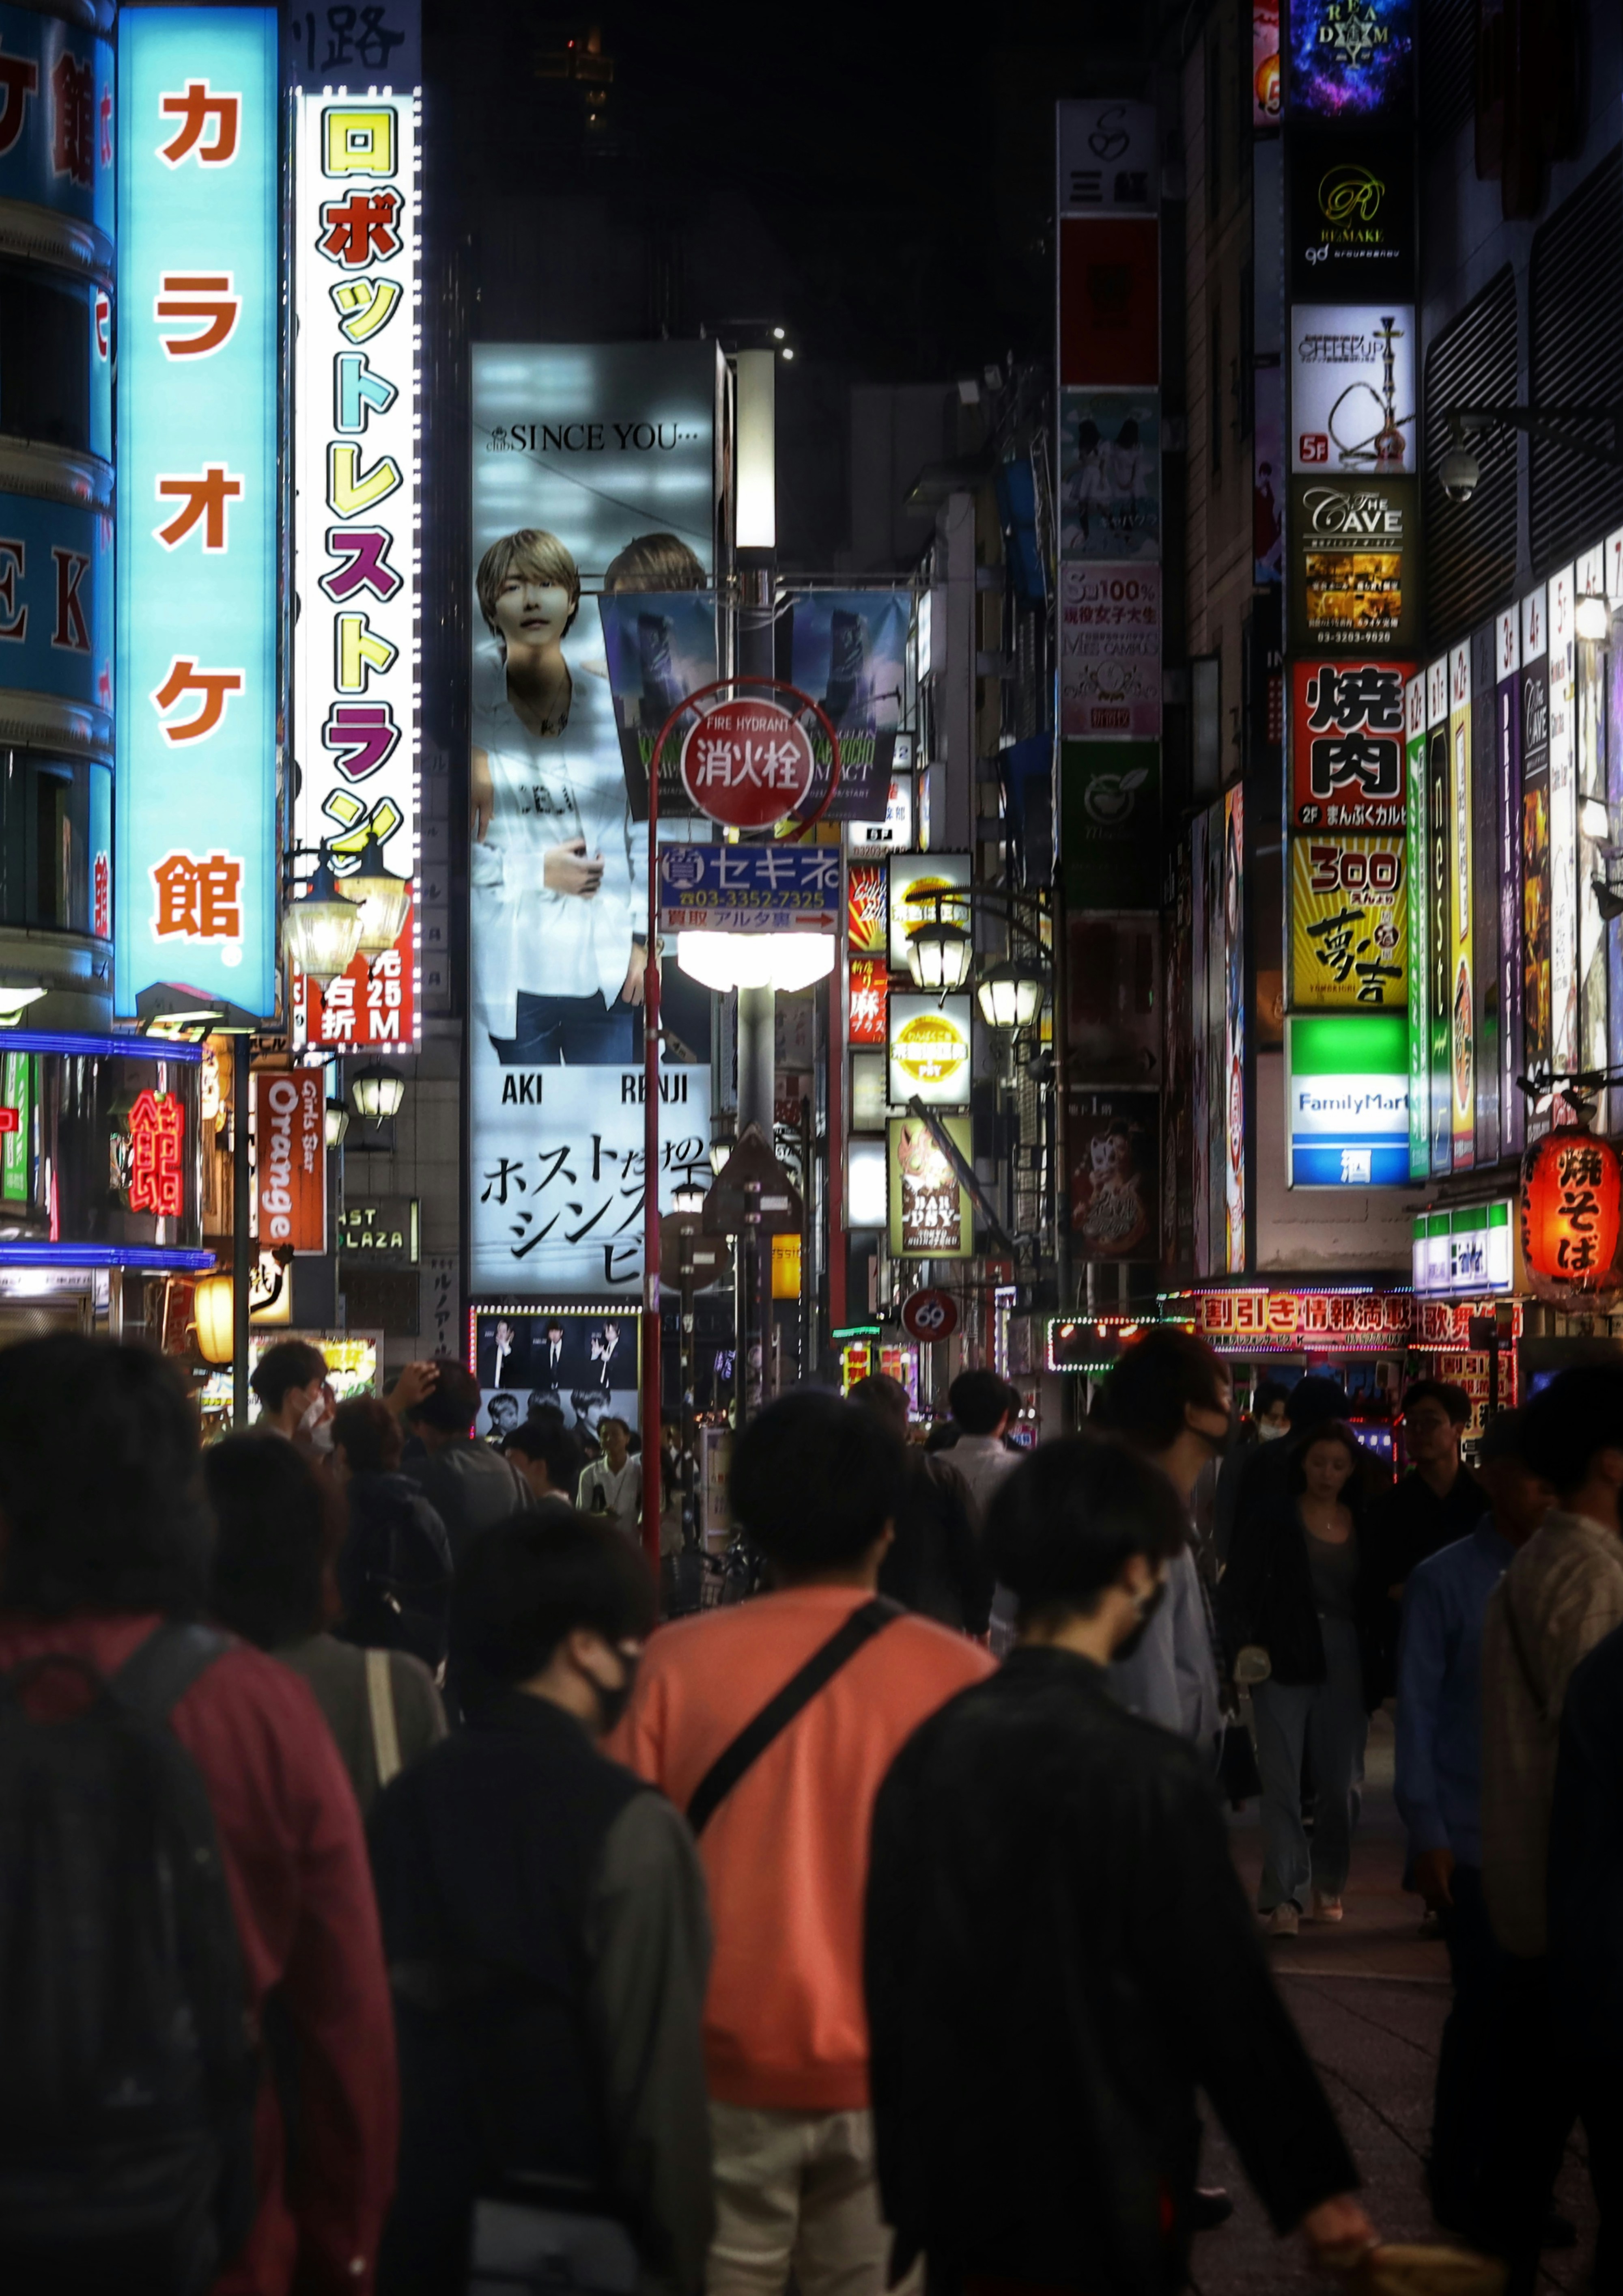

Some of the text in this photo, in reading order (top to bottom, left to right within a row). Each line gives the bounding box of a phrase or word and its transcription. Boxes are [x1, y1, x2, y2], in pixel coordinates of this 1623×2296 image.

[511, 423, 603, 452] SINCE
[154, 79, 243, 941] カラオケ館
[314, 106, 406, 873] ロボットレストラン
[1303, 486, 1403, 534] CAVE
[1503, 617, 1513, 670] 3F
[706, 714, 790, 733] FIRE HYDRANT
[1410, 682, 1423, 733] B2F
[1306, 665, 1404, 800] 焼肉
[695, 738, 802, 789] 消火栓
[710, 847, 840, 890] セキネ
[1310, 844, 1401, 896] 300
[668, 910, 791, 928] 買取 アルタ裏
[695, 889, 825, 908] 03-3352-7325
[301, 1080, 319, 1130] Girls
[502, 1073, 542, 1105] AKI
[1299, 1094, 1408, 1115] FamilyMart
[262, 1080, 299, 1239] Orange
[914, 1195, 951, 1210] BAR
[1557, 1147, 1602, 1271] 焼そば
[1202, 1294, 1413, 1332] 割引き情報満載
